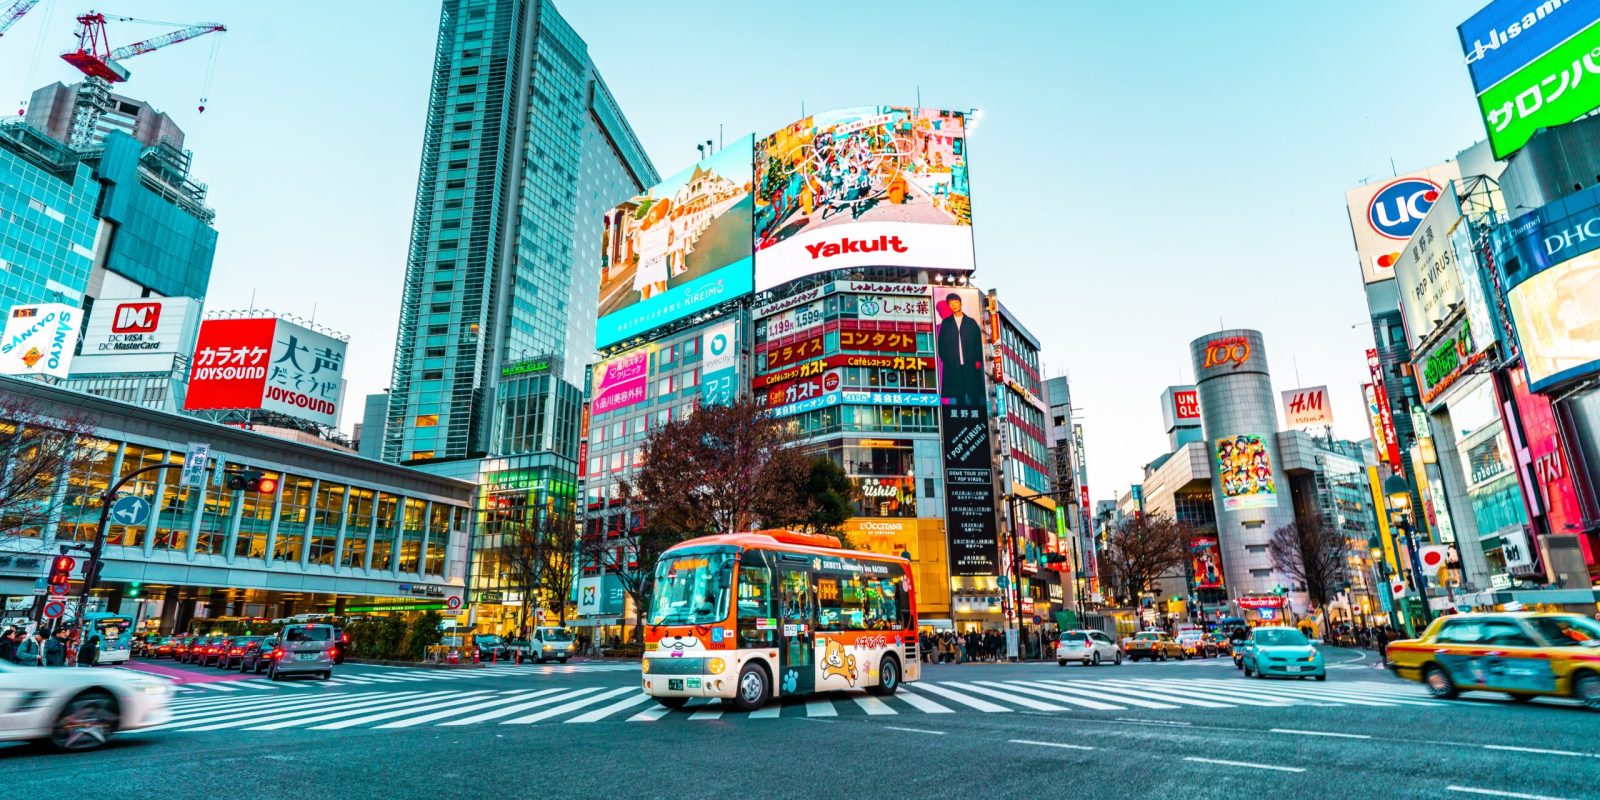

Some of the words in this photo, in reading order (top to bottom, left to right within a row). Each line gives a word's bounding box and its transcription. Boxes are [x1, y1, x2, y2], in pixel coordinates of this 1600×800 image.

[1510, 216, 1541, 239] Channel
[805, 235, 908, 259] Yakult
[684, 284, 725, 306] KIREIMO
[850, 282, 928, 294] しゃぶしゃぶバイキング
[883, 299, 930, 315] しゃぶ葉
[116, 306, 156, 329] DC
[2, 312, 56, 354] SANKYO
[108, 334, 123, 342] DC
[124, 333, 143, 342] VISA
[756, 326, 766, 337] 9F
[48, 310, 74, 370] SANKYO
[98, 343, 113, 351] DC
[113, 341, 161, 351] MasterCard
[840, 332, 914, 348] コンタクト
[197, 345, 268, 367] カラオケ
[277, 334, 343, 375] 大声
[1203, 342, 1251, 369] 109
[616, 355, 645, 371] 品川スキン
[892, 357, 928, 371] ガスト
[193, 366, 266, 381] JOYSOUND
[616, 365, 641, 380] クリニック
[266, 385, 335, 415] JOYSOUND
[600, 386, 643, 409] 品川美容外科
[785, 381, 820, 403] ガスト
[873, 394, 938, 404] 英会話イーオン
[755, 394, 768, 407] 7F
[1289, 390, 1323, 414] H&M
[862, 485, 898, 497] Ushi8
[823, 560, 842, 570] SHIBUYA
[855, 636, 888, 650] ハチ公バス
